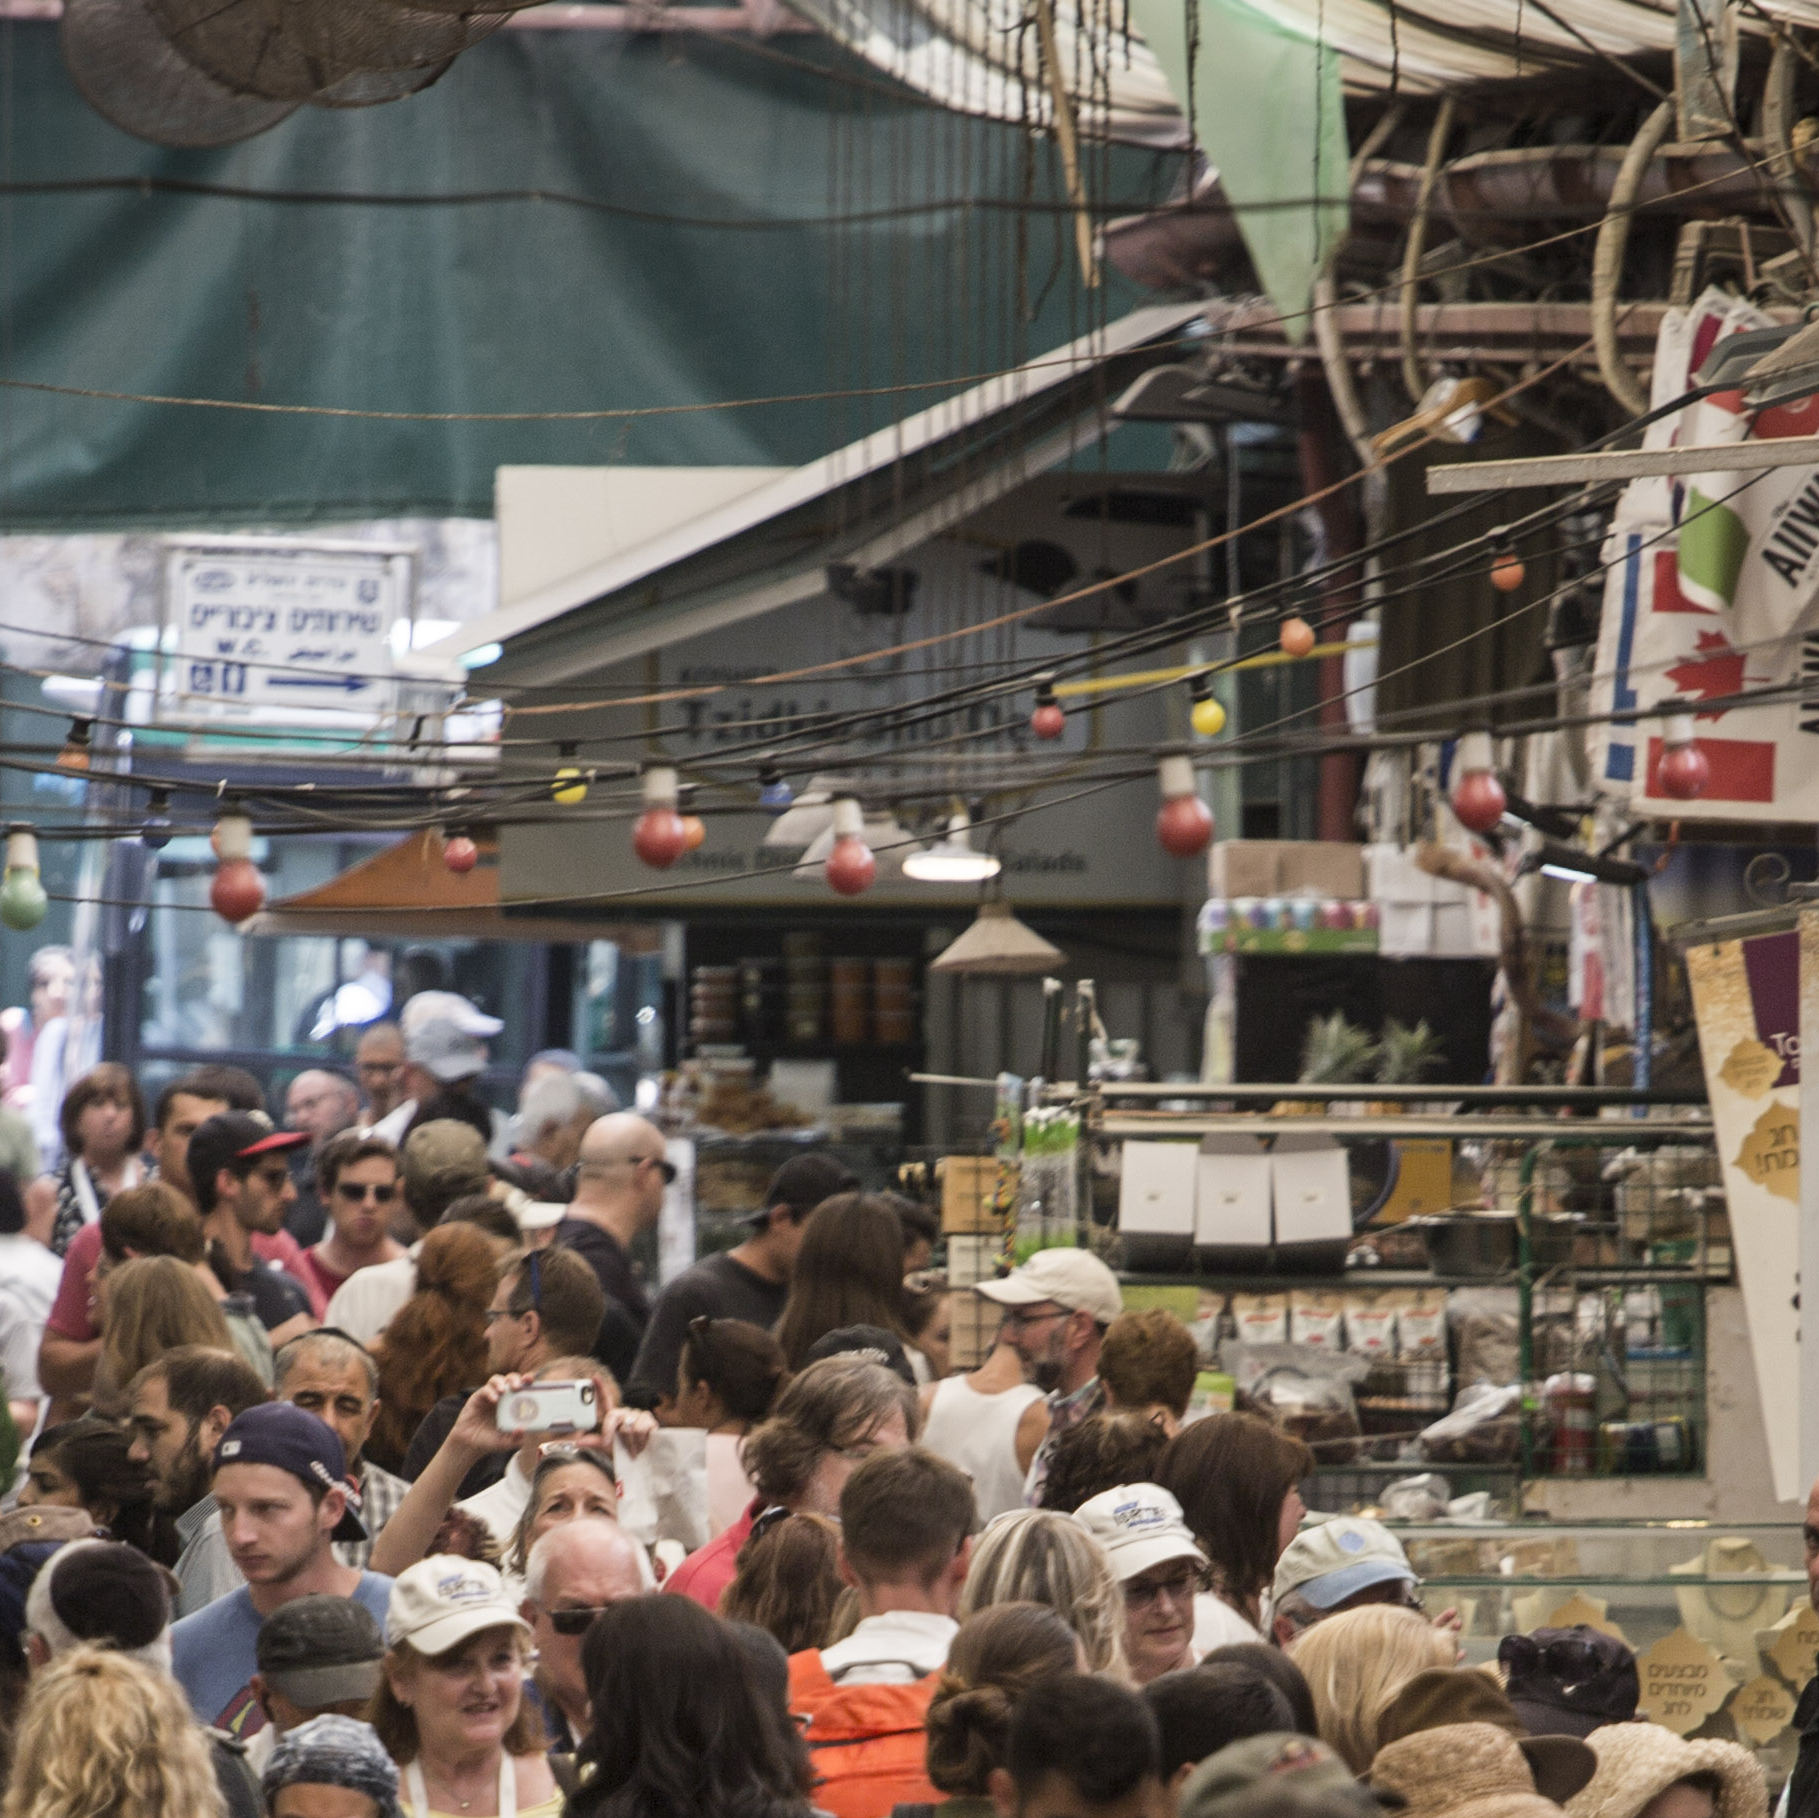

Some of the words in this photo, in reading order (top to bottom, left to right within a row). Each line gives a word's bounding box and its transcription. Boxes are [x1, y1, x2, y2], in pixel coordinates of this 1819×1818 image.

[290, 605, 380, 634] שירותים
[1770, 1031, 1801, 1057] To
[1648, 1663, 1709, 1679] מבצעים
[1648, 1682, 1707, 1698] מיוחדים
[1662, 1701, 1693, 1716] לחג
